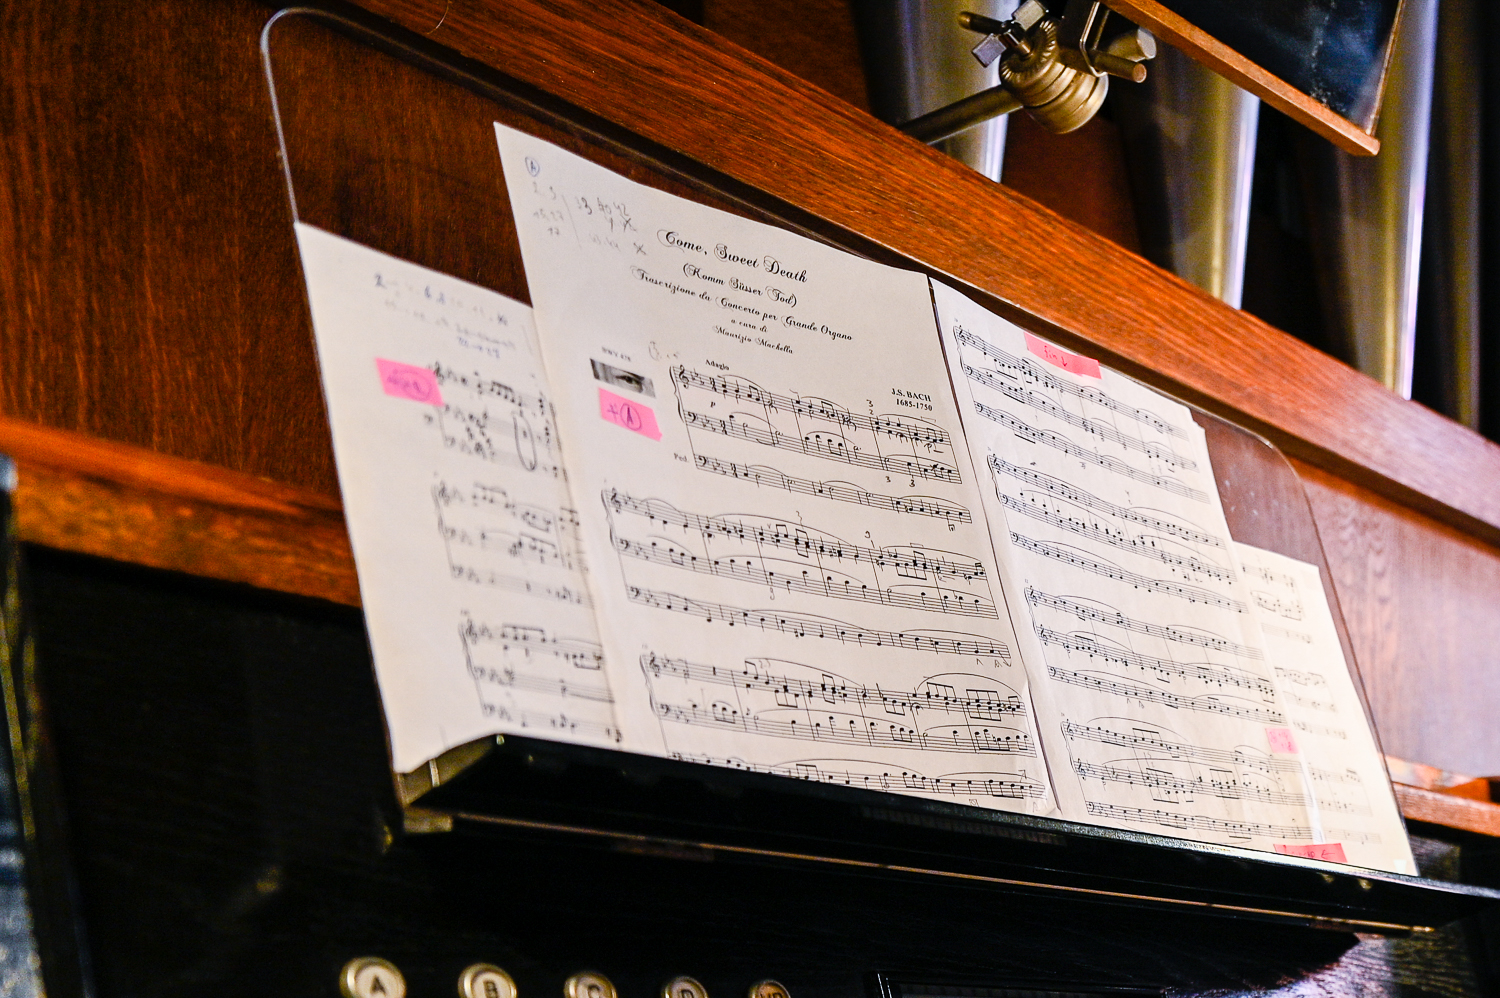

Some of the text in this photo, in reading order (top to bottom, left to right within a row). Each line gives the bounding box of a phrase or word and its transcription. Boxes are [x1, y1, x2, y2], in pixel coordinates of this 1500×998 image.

[656, 229, 808, 283] Come, Sweet Death
[682, 262, 797, 308] (Komm Süsser Tod)
[630, 265, 853, 341] Trascrizione da Concerto per Grande Organo
[712, 324, 752, 344] Maurizio
[739, 321, 757, 330] cura
[705, 359, 730, 371] Adagio
[891, 387, 931, 402] J.S. BACH
[896, 398, 933, 412] 1685-1750
[370, 975, 386, 995] A
